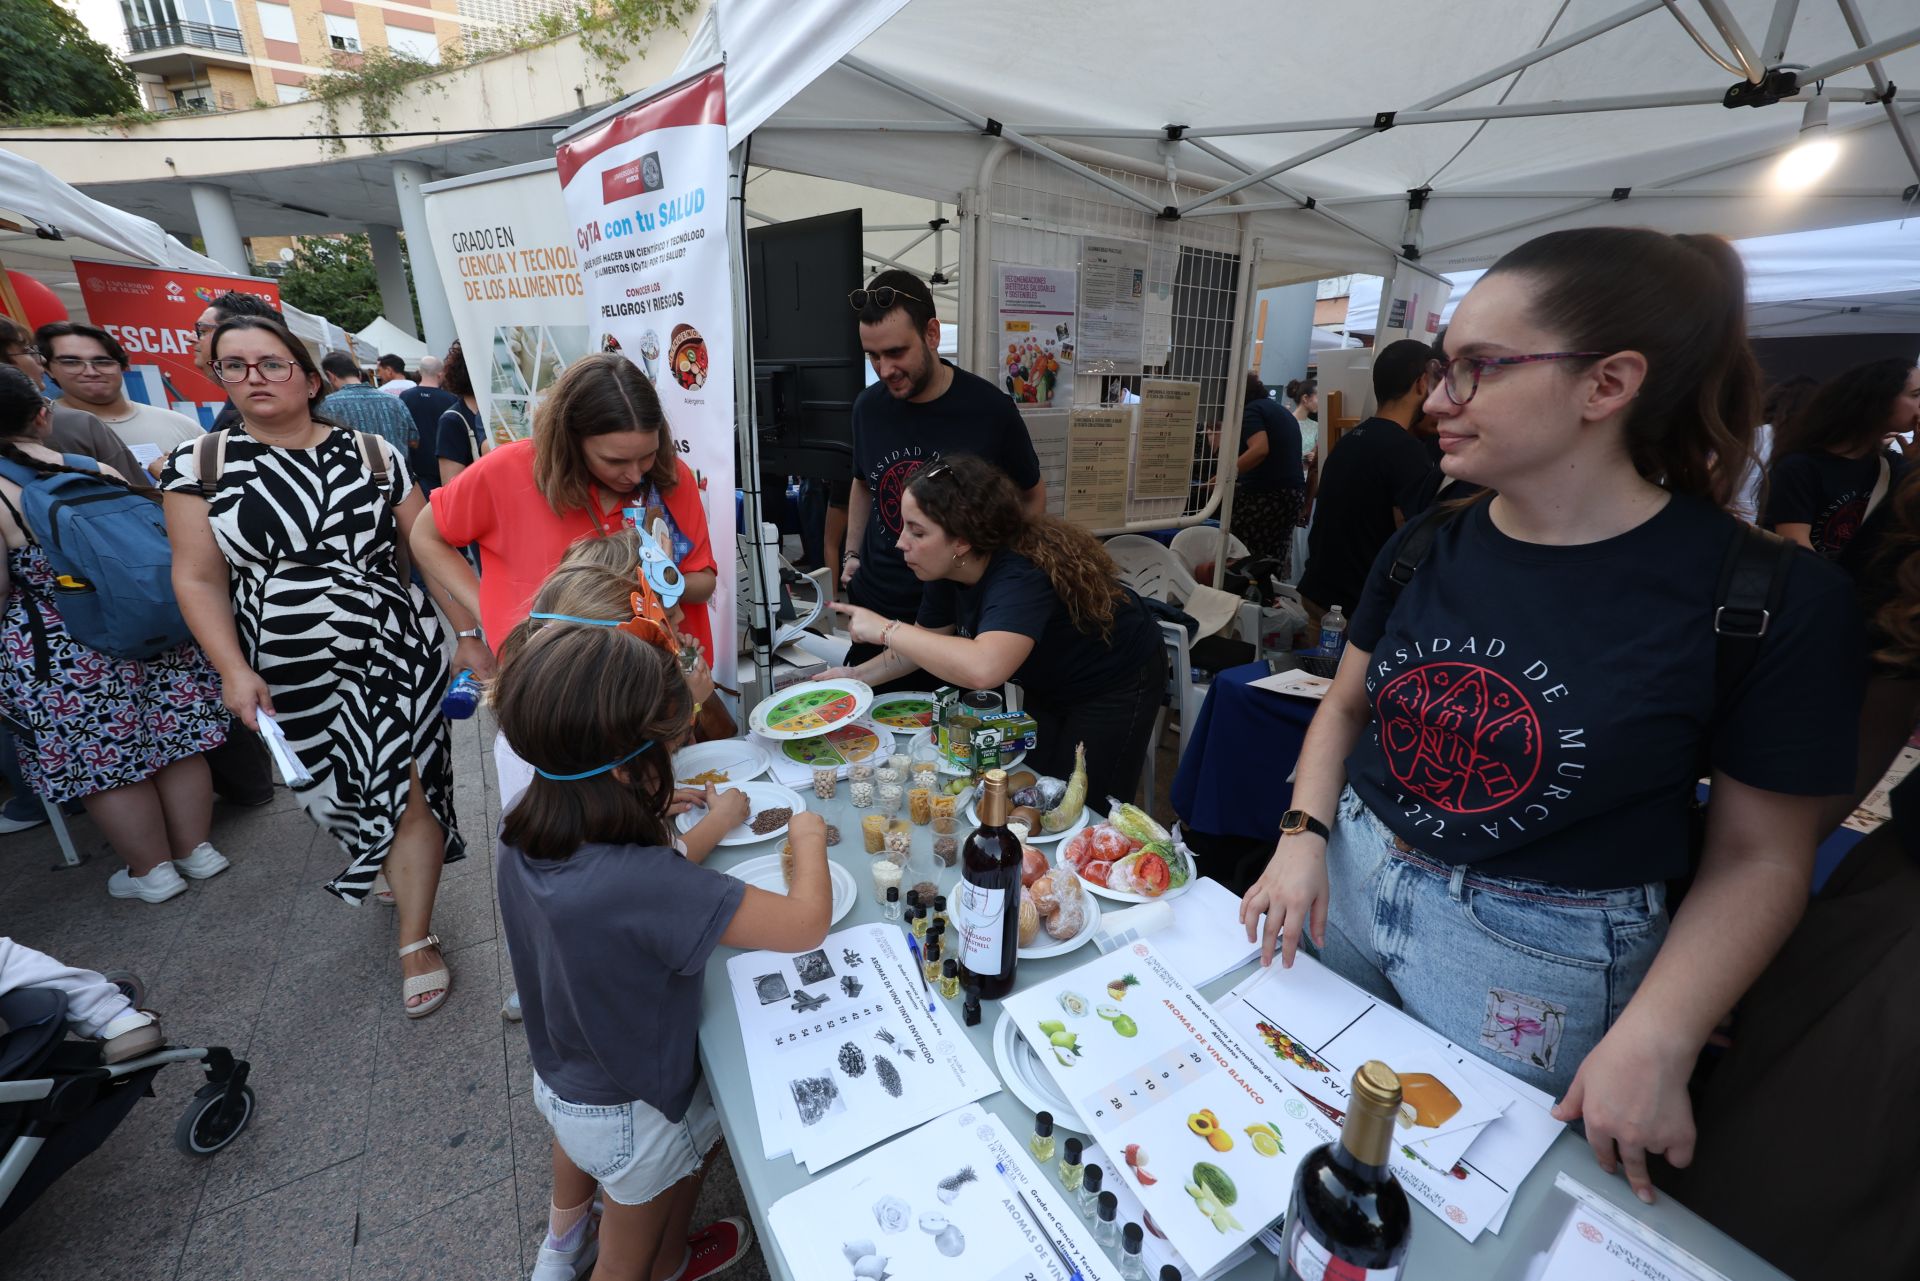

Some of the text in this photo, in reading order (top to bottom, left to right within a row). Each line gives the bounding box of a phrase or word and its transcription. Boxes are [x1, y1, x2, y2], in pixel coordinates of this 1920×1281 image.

[577, 187, 705, 250] CyTA con tu SALUD
[453, 226, 514, 253] GRADO EN
[459, 246, 578, 277] CIENCIA Y TECNOL
[603, 251, 623, 263] HACER
[625, 247, 636, 259] UN
[660, 255, 666, 265] TU
[464, 273, 583, 301] DE LOS ALIMENTOS
[626, 282, 661, 297] CONOCER LOS
[602, 292, 684, 318] PELIGROS Y RIESGOS
[1522, 660, 1569, 703] DE
[982, 713, 1020, 721] Calvo
[1480, 728, 1586, 839] MURCIA
[1396, 793, 1446, 838] 1272
[840, 1016, 847, 1024] 51
[852, 1012, 859, 1020] 42
[864, 1008, 871, 1016] 41
[870, 957, 935, 1064] AROMAS DE VINO TINTO ENVEJECIDO
[876, 1004, 883, 1012] 40
[814, 1024, 822, 1032] 53
[827, 1020, 835, 1028] 52
[1162, 999, 1264, 1105] AROMAS DE VINO BLANCO
[1185, 994, 1202, 1012] Grado
[1201, 1011, 1210, 1020] en
[1209, 1019, 1229, 1039] Ciencia
[1233, 1043, 1264, 1075] Tecnología
[1264, 1074, 1273, 1083] de
[1272, 1082, 1283, 1093] los
[1211, 1030, 1239, 1059] Alimentos
[1190, 1052, 1202, 1063] 20
[1145, 1079, 1155, 1090] 10
[1110, 1098, 1122, 1110] 28
[993, 1139, 1029, 1185] UNIVERSIDAD
[1001, 1198, 1038, 1244] AROMAS
[1034, 1243, 1049, 1260] DE
[1031, 1188, 1048, 1212] Grado
[1047, 1212, 1056, 1222] en
[1054, 1221, 1075, 1249] Ciencia
[1073, 1248, 1080, 1256] y
